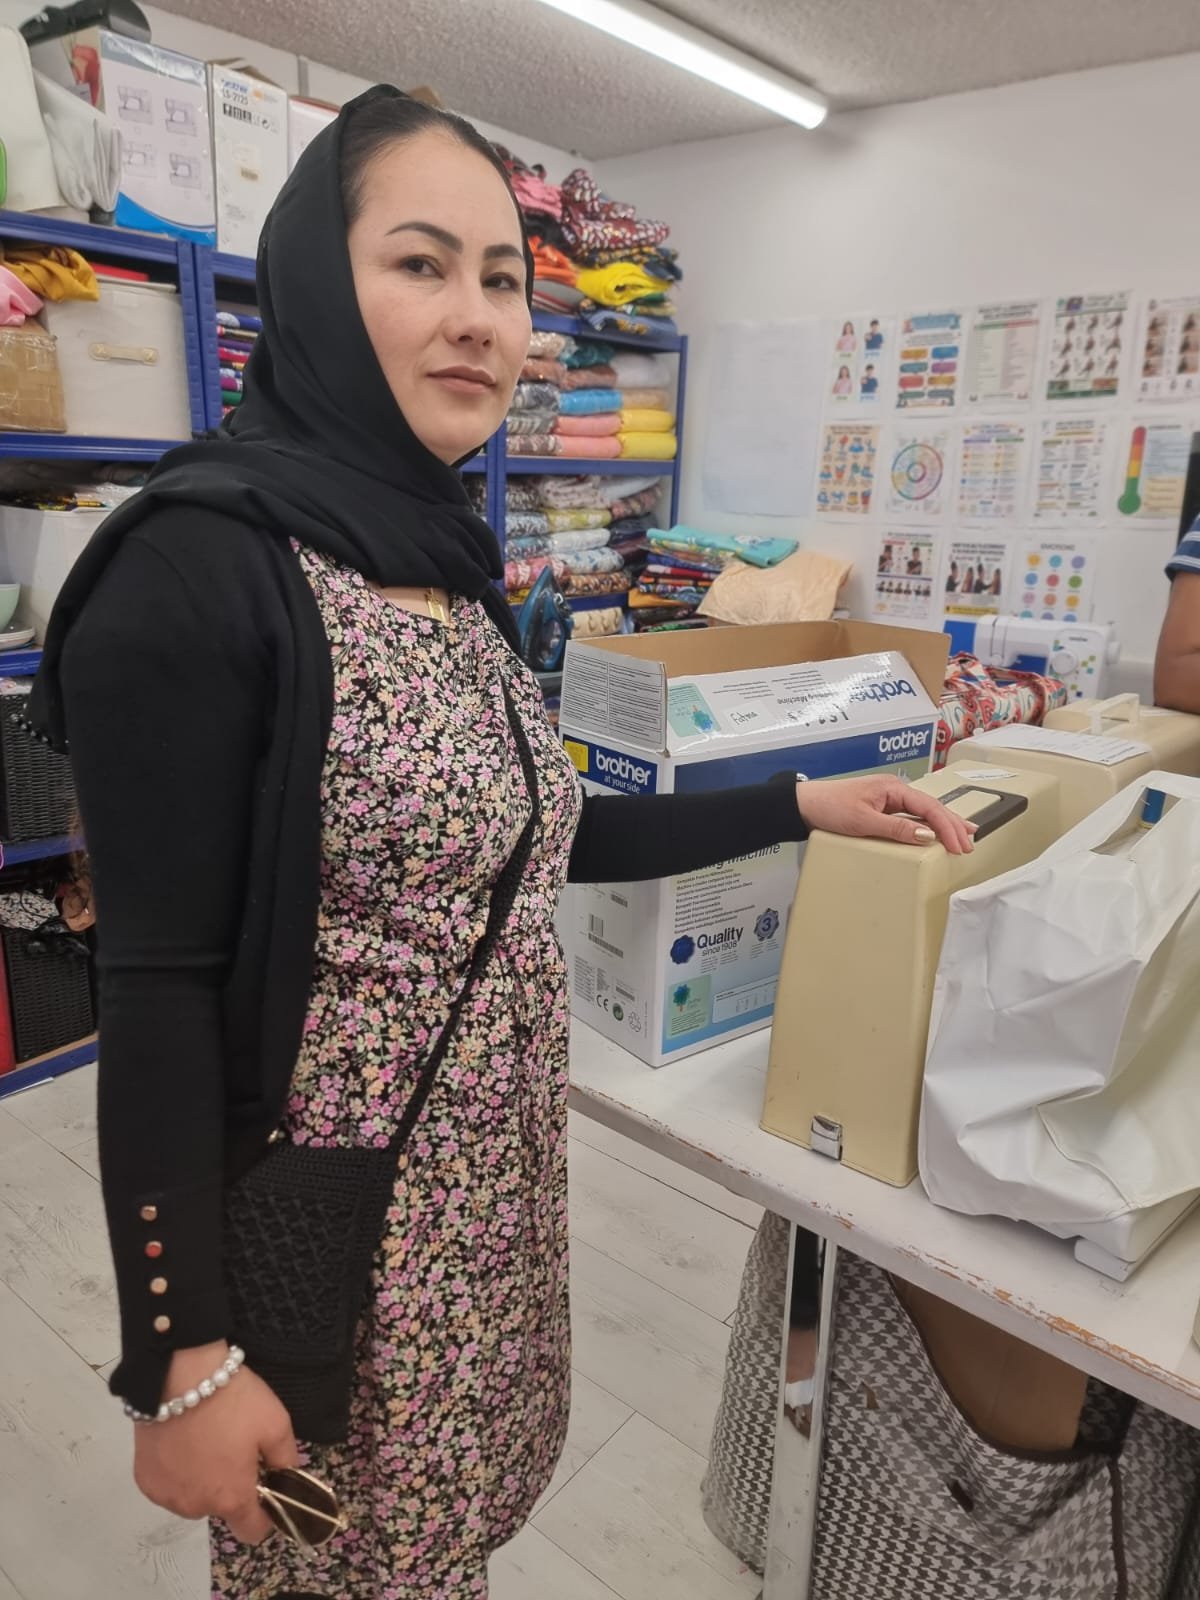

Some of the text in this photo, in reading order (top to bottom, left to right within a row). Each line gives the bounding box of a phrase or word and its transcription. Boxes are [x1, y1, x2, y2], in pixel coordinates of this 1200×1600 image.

[879, 729, 930, 753] brother
[886, 753, 893, 761] at
[893, 750, 907, 762] your
[595, 749, 652, 786] brother
[604, 775, 640, 794] at your side
[761, 917, 772, 932] 3
[697, 926, 744, 950] Quality
[702, 945, 720, 957] since
